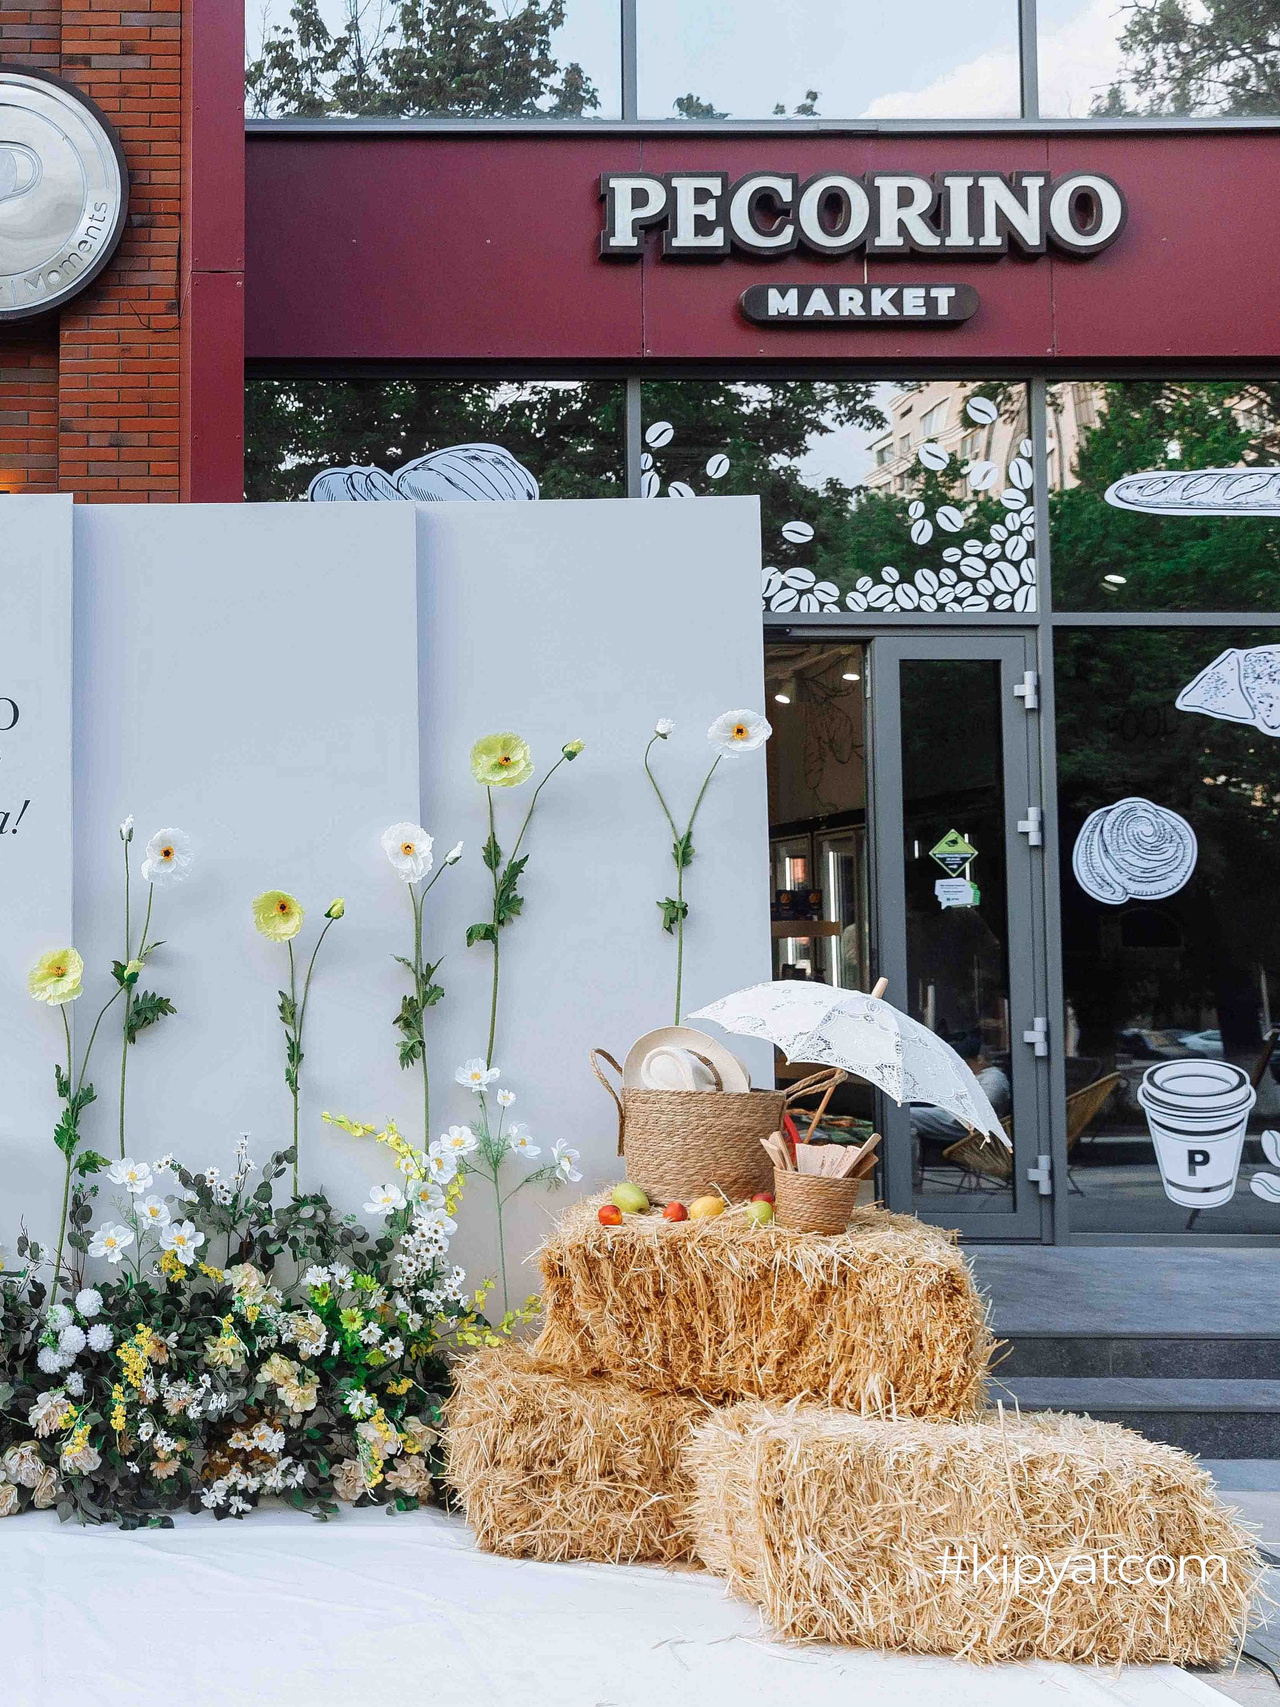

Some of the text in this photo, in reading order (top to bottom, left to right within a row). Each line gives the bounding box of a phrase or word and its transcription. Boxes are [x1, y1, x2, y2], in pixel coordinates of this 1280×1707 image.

[607, 175, 1123, 249] PECORINO
[24, 201, 108, 297] Moments
[766, 287, 957, 317] MARKET
[1187, 1149, 1210, 1177] P
